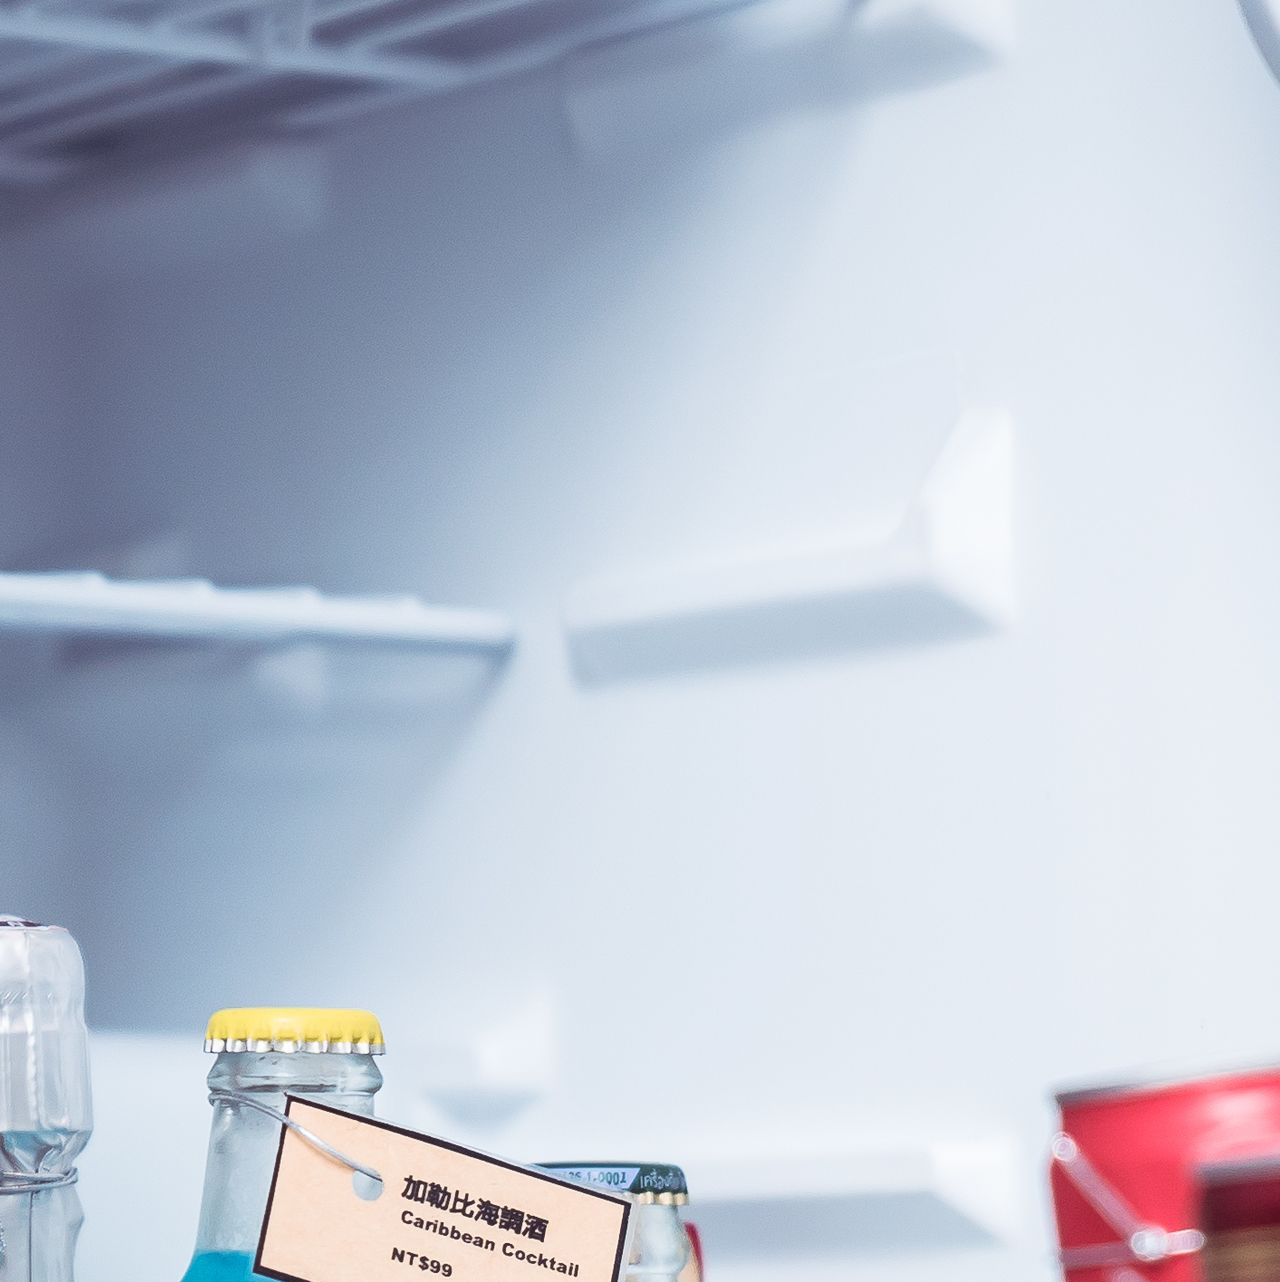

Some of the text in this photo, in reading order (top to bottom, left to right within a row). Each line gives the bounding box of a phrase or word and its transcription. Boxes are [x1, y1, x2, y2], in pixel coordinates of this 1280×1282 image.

[401, 1175, 549, 1243] 加勒比海調酒
[391, 1247, 453, 1278] NT$99
[401, 1210, 580, 1278] Caribbean Cocktail
